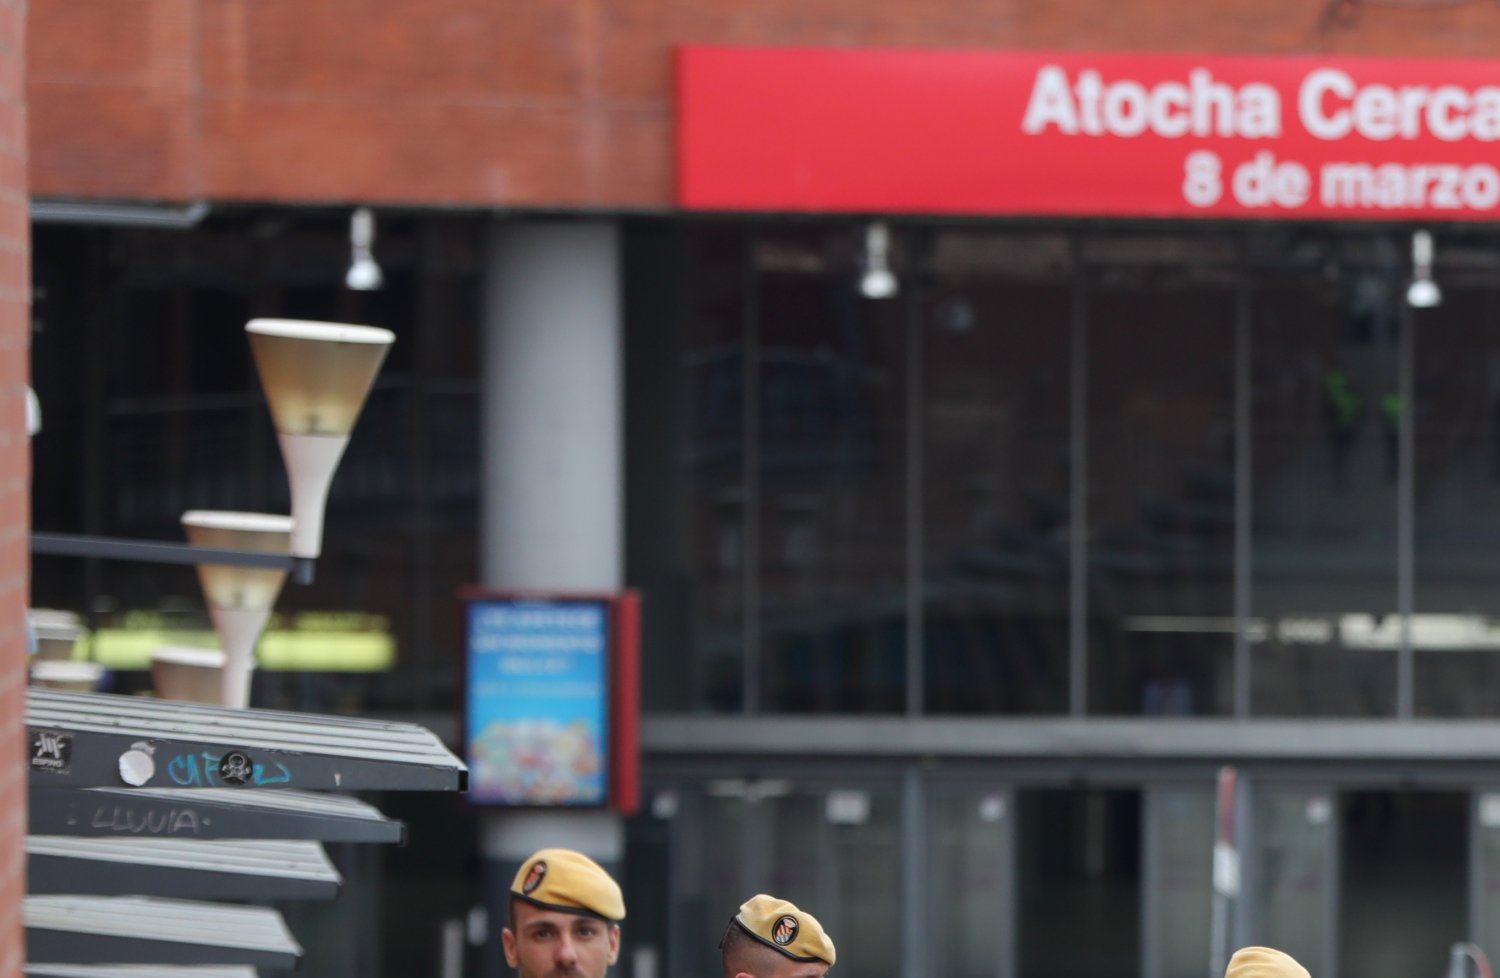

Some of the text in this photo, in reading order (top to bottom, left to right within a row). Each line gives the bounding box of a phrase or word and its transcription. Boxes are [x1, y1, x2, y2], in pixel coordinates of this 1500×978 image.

[1021, 64, 1282, 139] Atocha
[1182, 150, 1223, 207] 8
[1232, 149, 1312, 208] de
